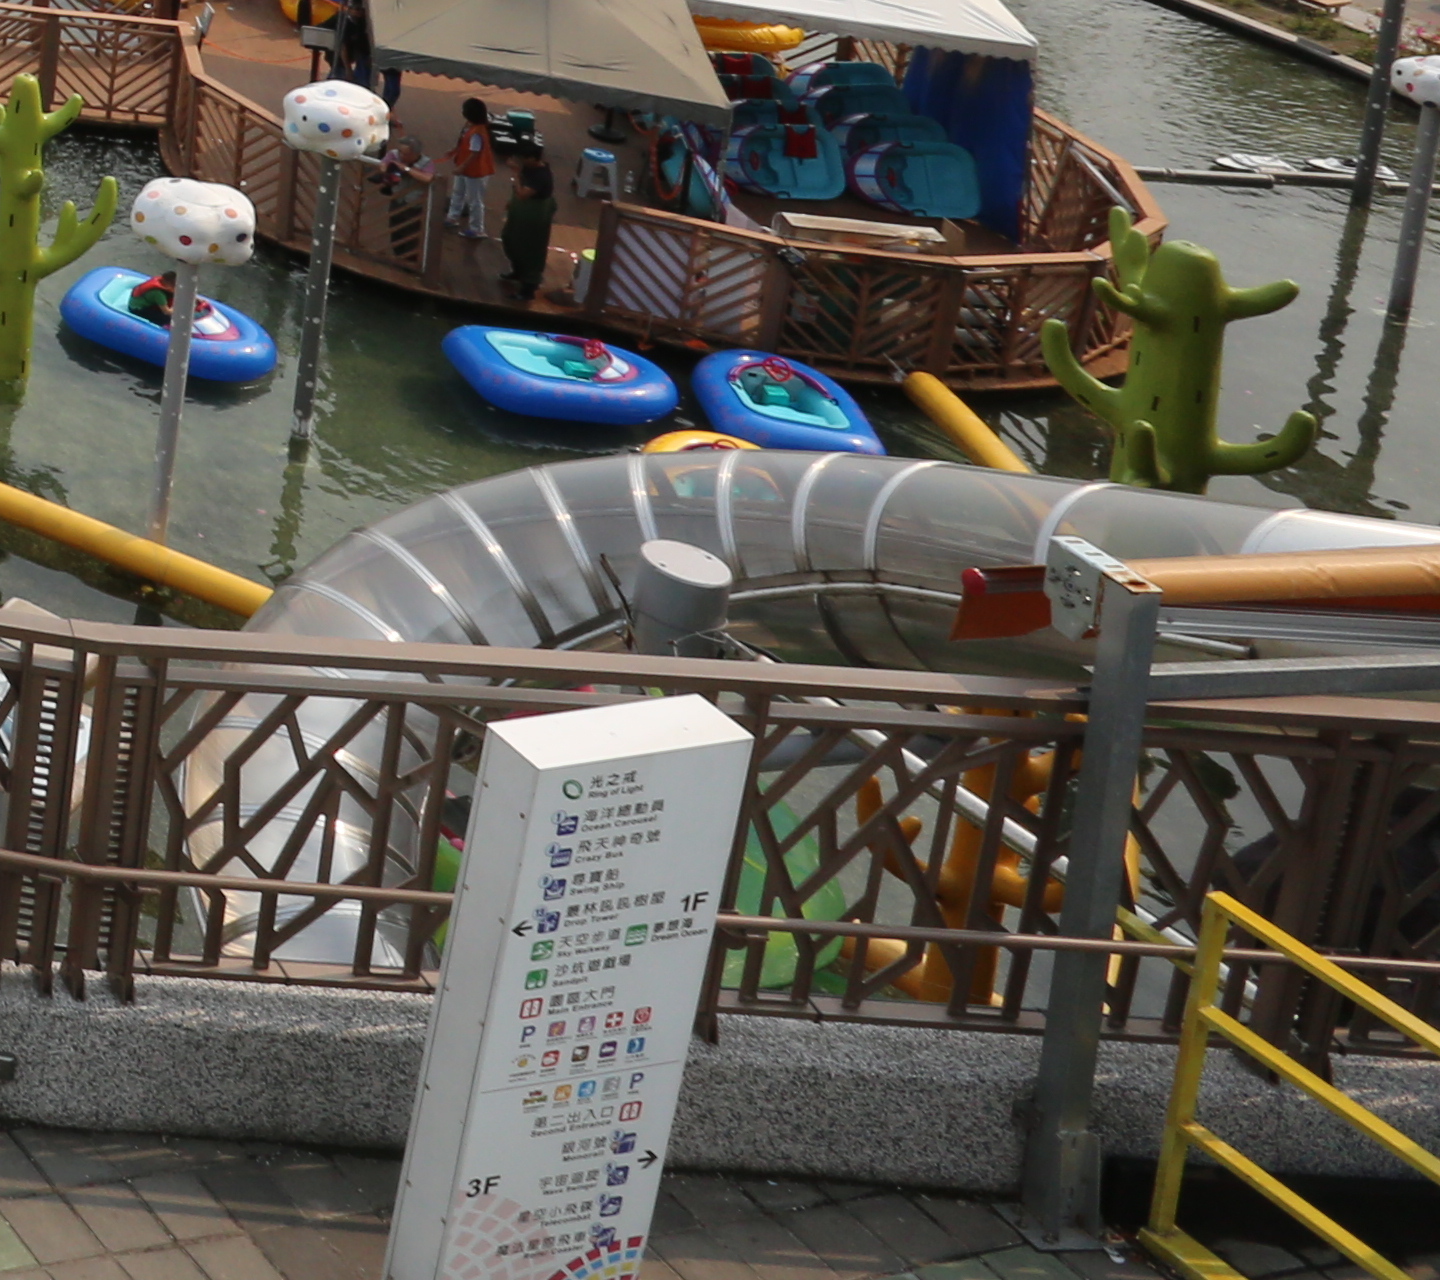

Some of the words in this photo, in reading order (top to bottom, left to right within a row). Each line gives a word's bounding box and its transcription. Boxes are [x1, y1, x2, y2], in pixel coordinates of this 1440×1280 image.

[590, 770, 637, 789] 光之戒
[588, 790, 609, 799] Ring
[621, 784, 644, 794] Light
[584, 799, 665, 823] 海洋總動員
[581, 822, 612, 833] Ocean
[614, 814, 658, 828] Carousel
[577, 829, 661, 854] 飛天神奇號
[575, 854, 602, 864] Crazy
[569, 886, 600, 896] Swing
[603, 881, 625, 891] Ship
[680, 891, 709, 912] 1F
[564, 916, 587, 927] Drop
[591, 913, 619, 923] Tower
[558, 927, 621, 948] 天空步道
[651, 933, 679, 942] Dream
[681, 928, 708, 938] Ocean
[556, 949, 572, 958] Sky
[575, 944, 610, 955] Walkway
[552, 976, 588, 988] Sandpit
[549, 986, 615, 1007] 園區大門
[547, 1006, 569, 1016] Main
[573, 1000, 613, 1012] Entrance
[520, 1025, 537, 1043] P
[629, 1072, 645, 1089] P
[533, 1106, 614, 1129] 第二出入口
[530, 1126, 566, 1138] Second
[569, 1119, 612, 1132] Entrance
[562, 1150, 605, 1162] Monorail
[466, 1175, 501, 1198] 3F
